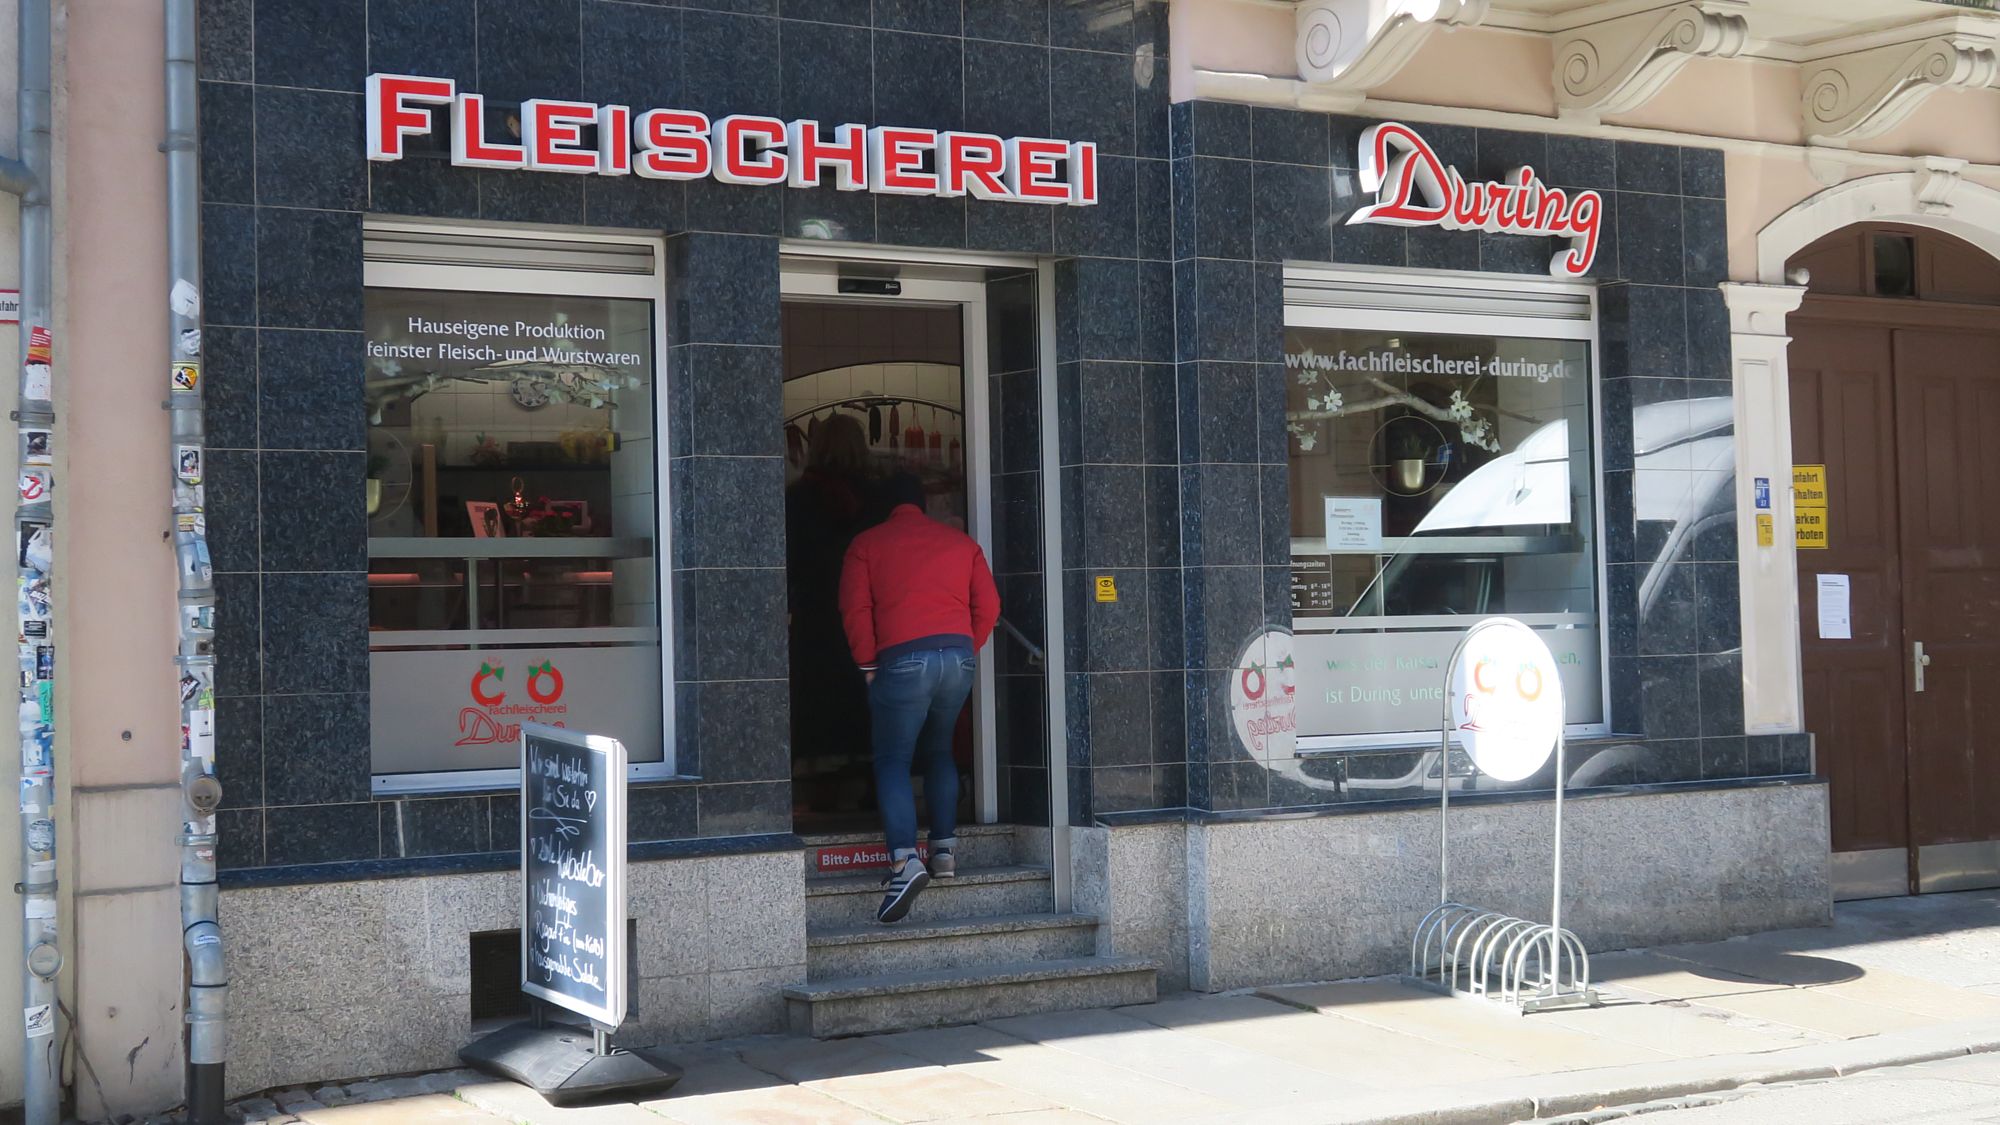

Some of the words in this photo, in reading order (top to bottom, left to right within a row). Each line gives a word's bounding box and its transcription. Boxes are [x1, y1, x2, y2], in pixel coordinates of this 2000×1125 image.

[366, 72, 1099, 206] FLEISCHEREI
[1346, 122, 1602, 277] During
[0, 301, 18, 312] fahr
[408, 317, 509, 340] Hauseigene
[515, 321, 605, 340] Produktion
[367, 341, 432, 359] feinster
[505, 347, 537, 361] und
[542, 347, 641, 366] Wurstwaren
[1795, 513, 1820, 524] arken
[1796, 528, 1824, 539] rboten
[1326, 687, 1343, 703] ist
[1351, 686, 1401, 706] During
[1410, 685, 1444, 700] unte
[553, 784, 569, 808] Sie
[571, 790, 580, 810] da
[822, 853, 850, 866] Bitte
